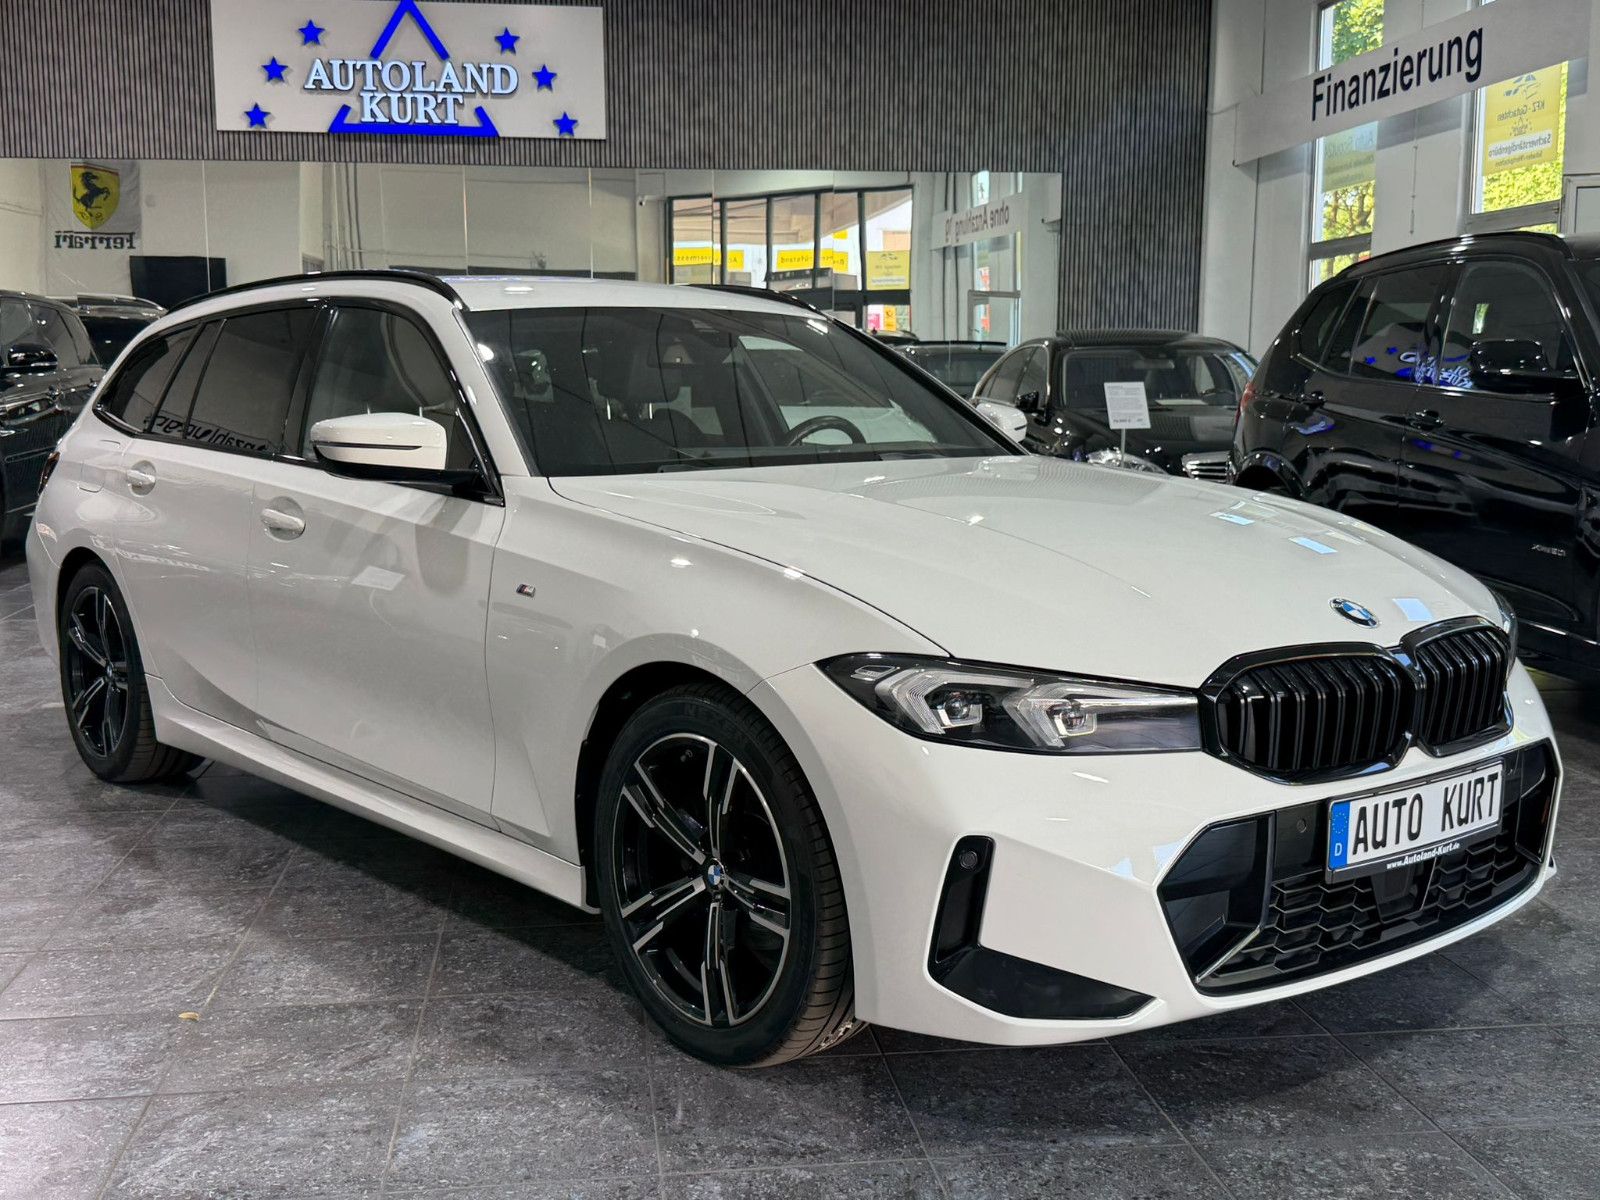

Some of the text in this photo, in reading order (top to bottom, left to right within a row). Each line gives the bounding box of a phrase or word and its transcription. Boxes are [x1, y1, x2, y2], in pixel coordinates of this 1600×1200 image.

[303, 58, 520, 96] AUTOLAND
[1311, 27, 1484, 122] Finanzierung
[359, 91, 465, 125] KURT
[1352, 772, 1499, 856] AUTO KURT
[1334, 842, 1343, 857] D
[1386, 842, 1461, 870] www.Autoland-Kurt.de
